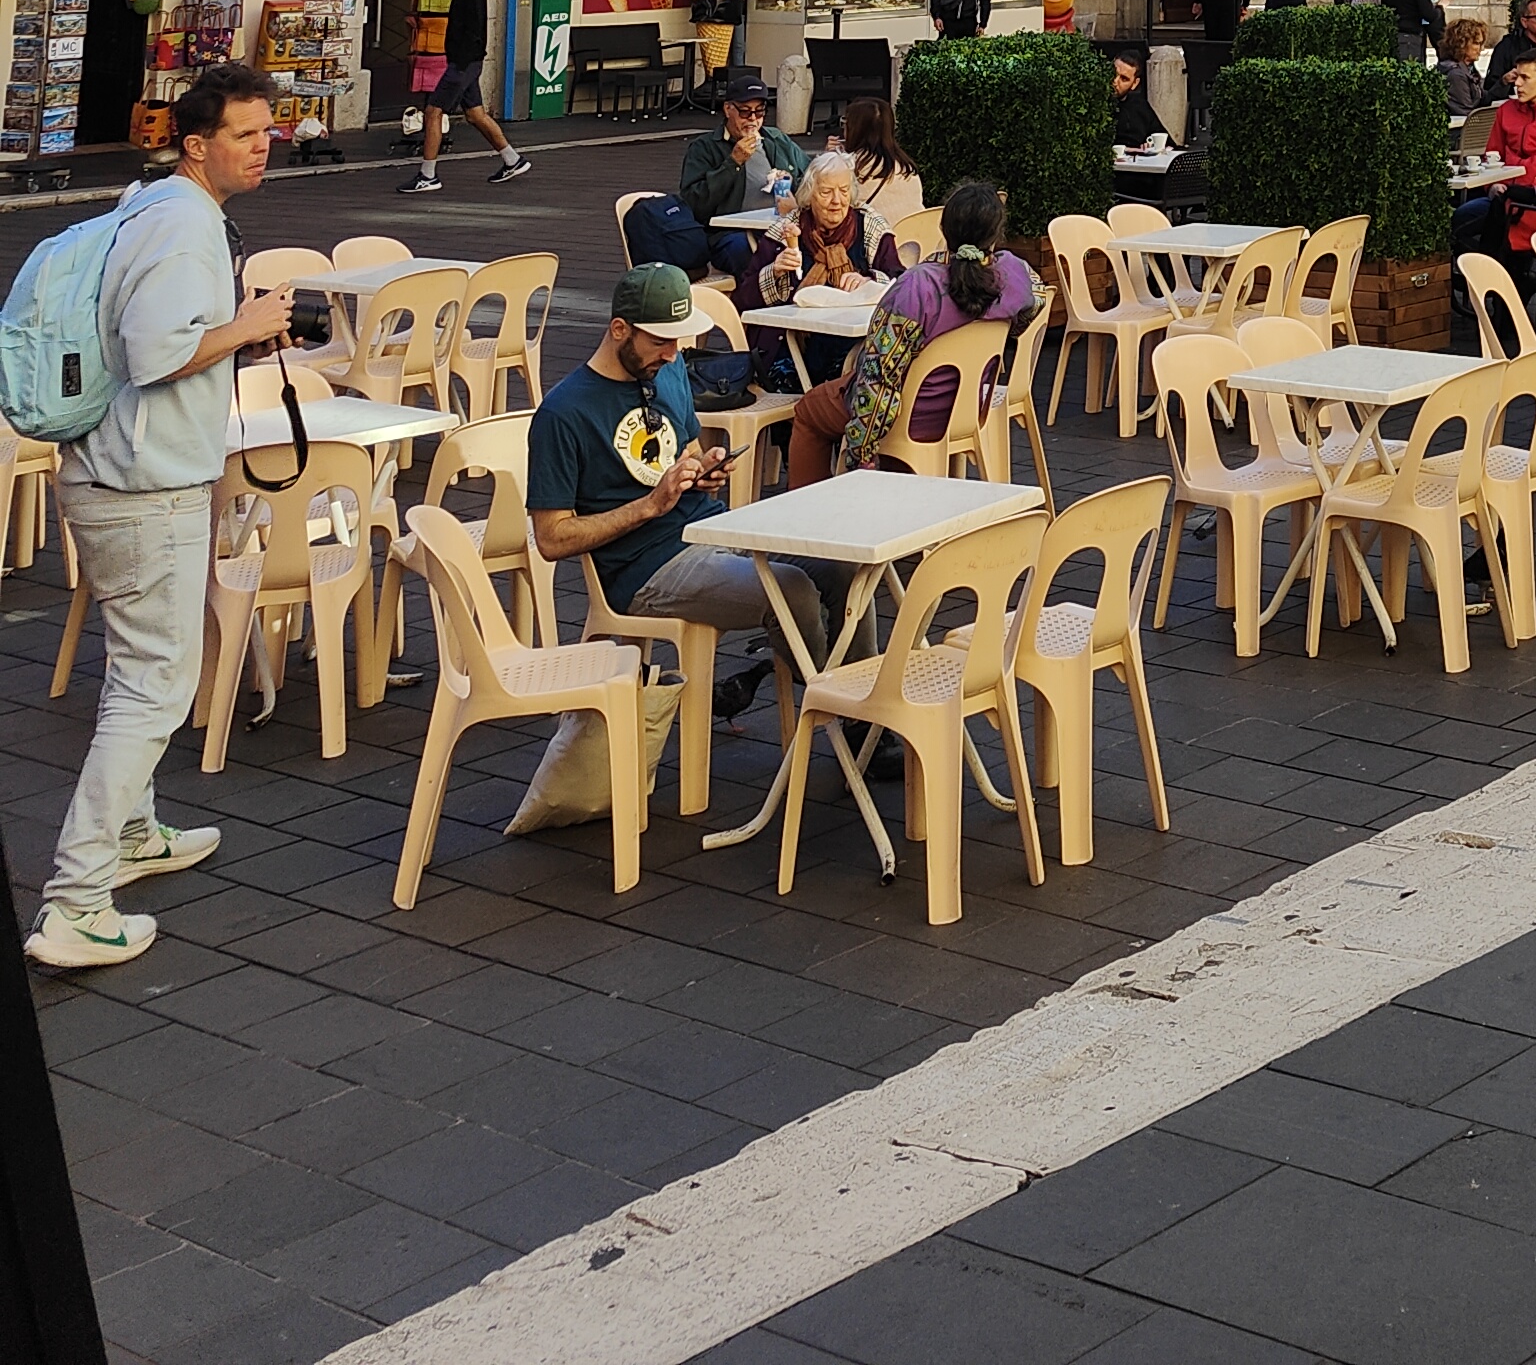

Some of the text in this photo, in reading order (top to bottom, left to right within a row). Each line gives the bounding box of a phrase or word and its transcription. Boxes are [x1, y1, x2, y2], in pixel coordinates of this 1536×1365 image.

[541, 12, 569, 23] AED
[61, 41, 77, 53] MC
[536, 83, 563, 96] DAE
[617, 413, 668, 450] TUSKR
[635, 466, 657, 486] FINEST
